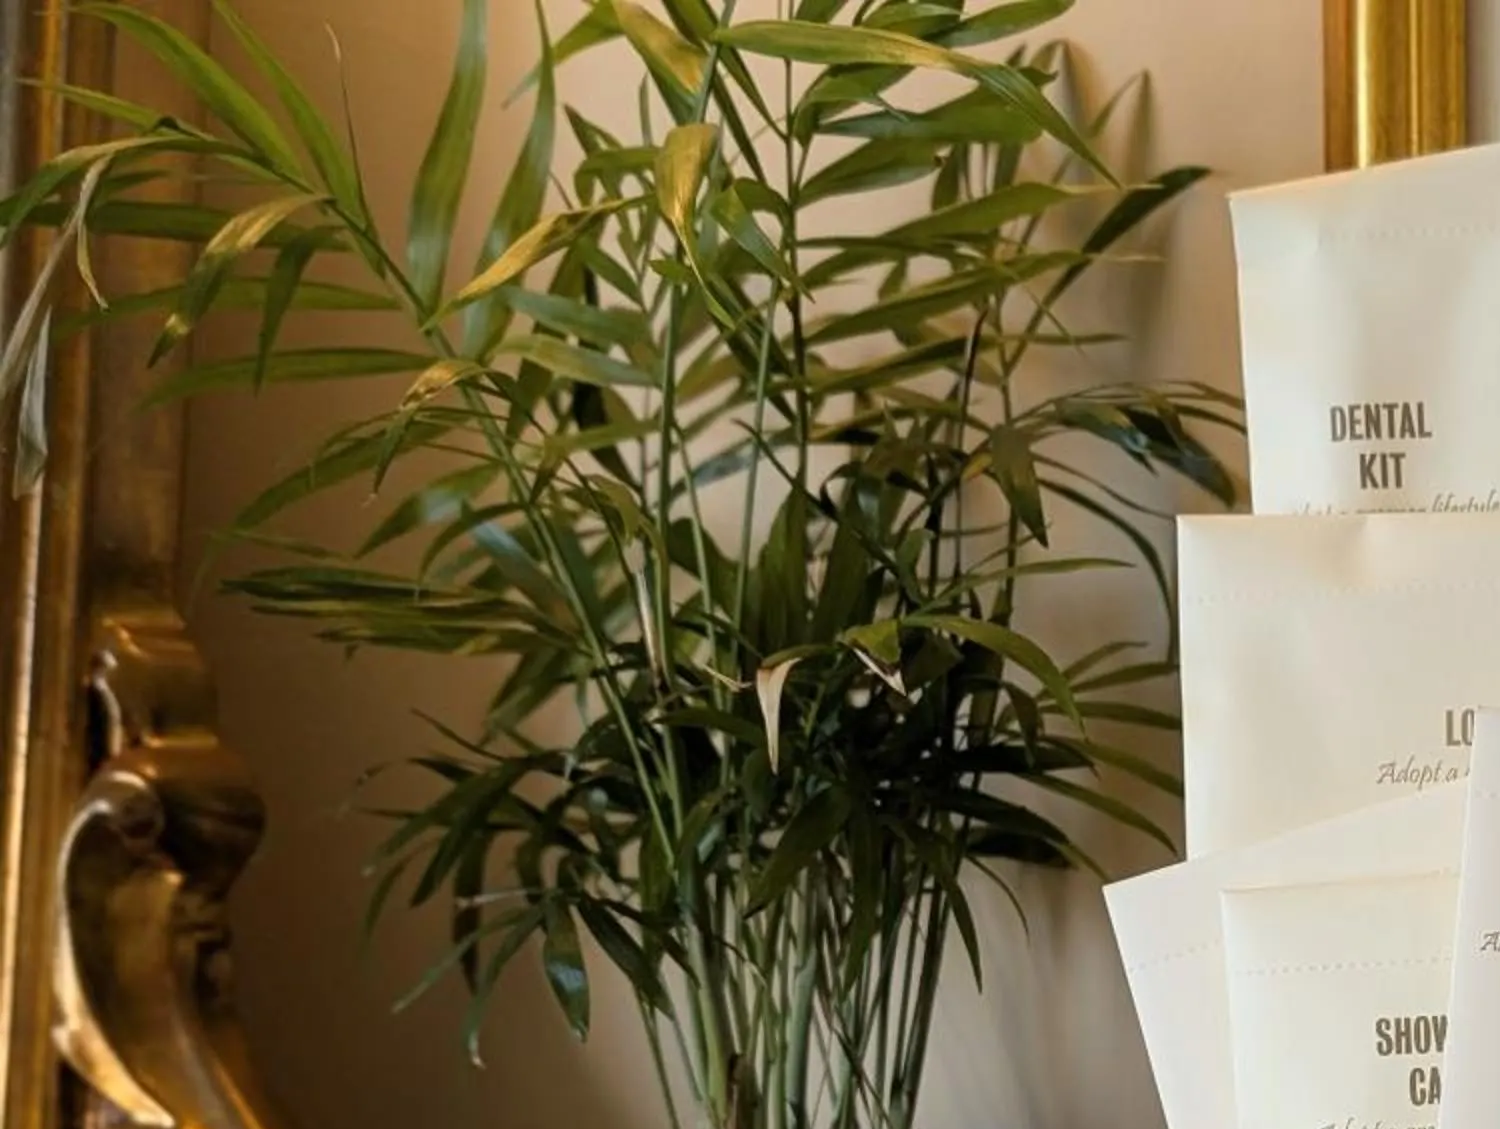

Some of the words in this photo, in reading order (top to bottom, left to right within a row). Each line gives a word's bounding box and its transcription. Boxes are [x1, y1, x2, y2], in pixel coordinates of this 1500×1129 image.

[1330, 401, 1432, 442] DENTAL
[1359, 452, 1406, 489] KIT
[1376, 755, 1443, 790] Adopt
[1445, 767, 1458, 782] a
[1409, 1066, 1442, 1106] CA
